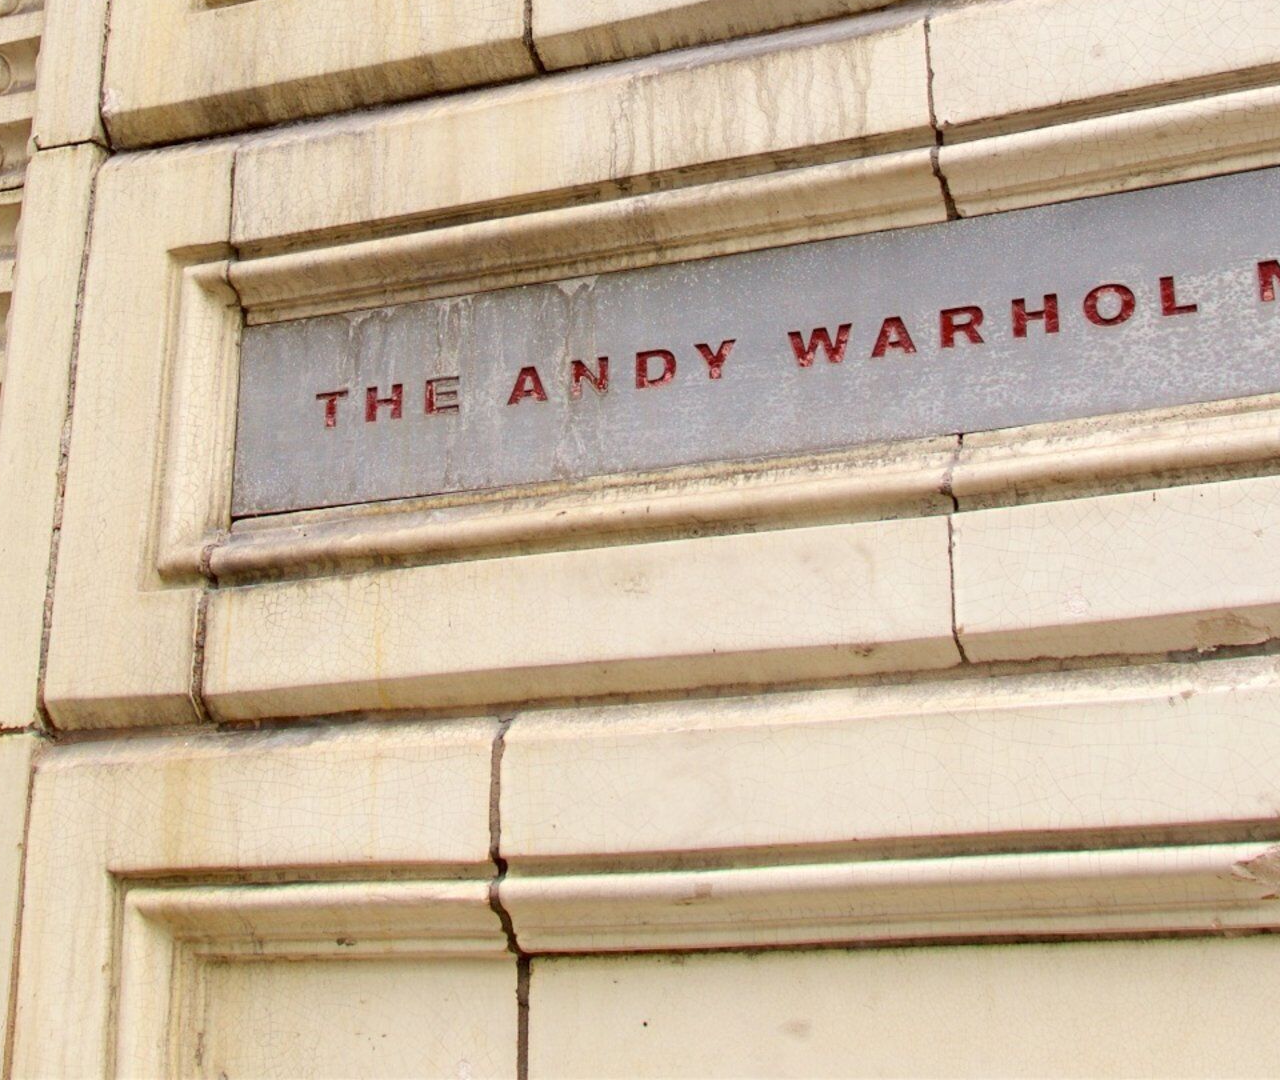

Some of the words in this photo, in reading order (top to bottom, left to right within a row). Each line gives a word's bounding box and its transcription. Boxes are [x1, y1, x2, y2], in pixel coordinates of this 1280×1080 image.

[317, 372, 460, 430] THE
[507, 336, 739, 407] ANDY
[786, 274, 1200, 369] WARHOL
